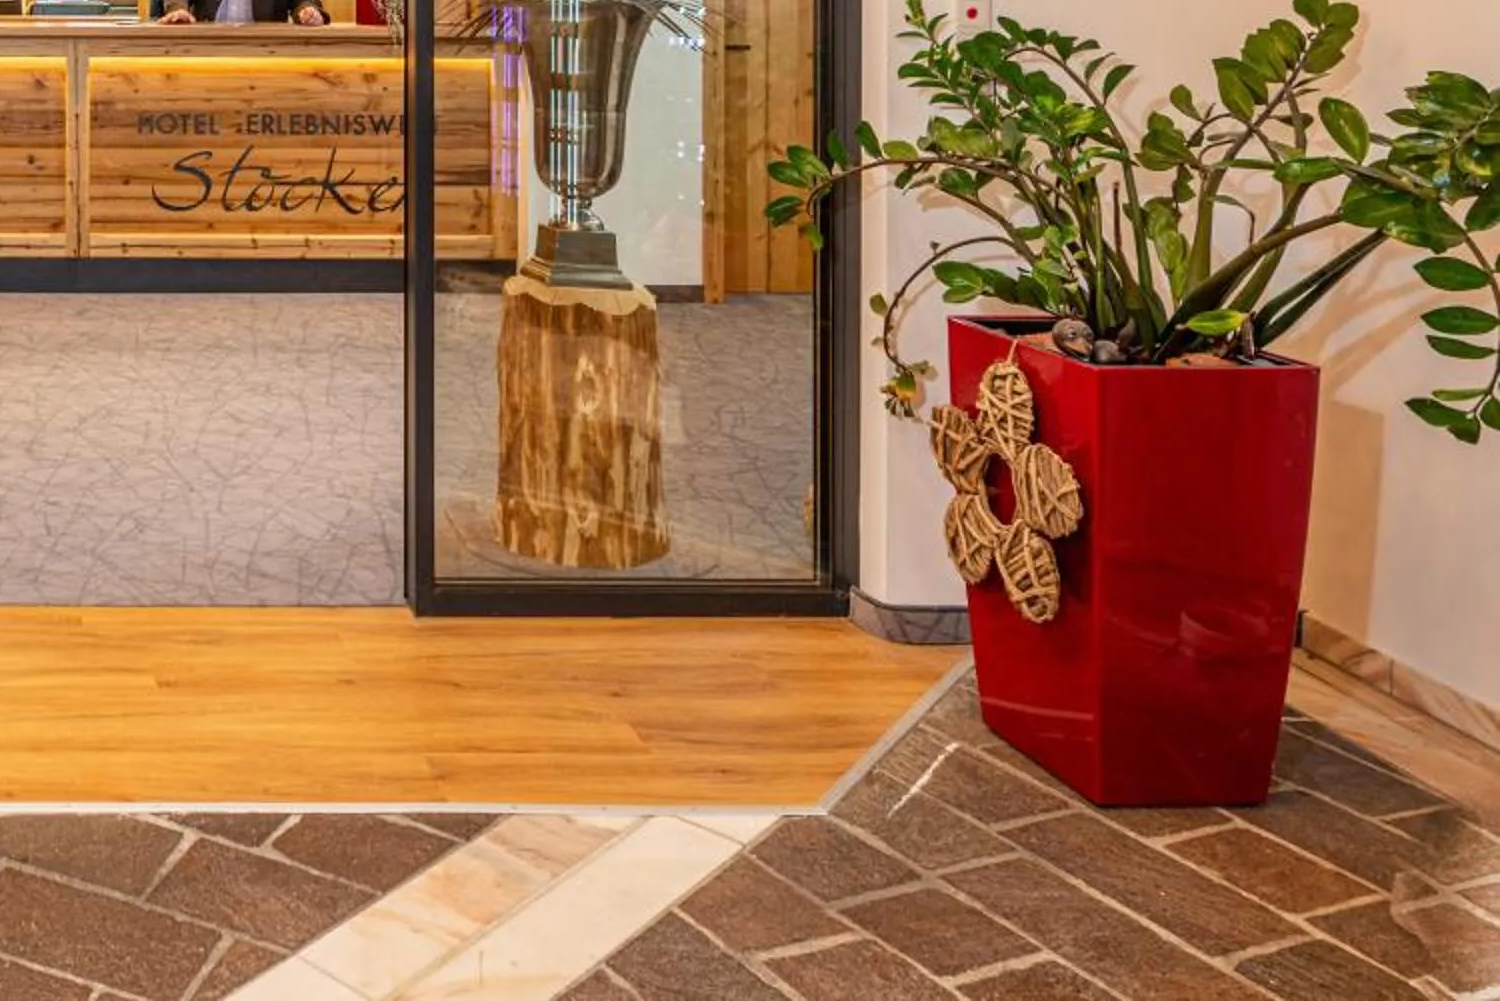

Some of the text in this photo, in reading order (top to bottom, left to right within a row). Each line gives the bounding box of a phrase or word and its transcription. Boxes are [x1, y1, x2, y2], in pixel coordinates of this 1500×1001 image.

[137, 112, 404, 136] HOTEL ERLEBNISW
[151, 144, 404, 215] Stocke
